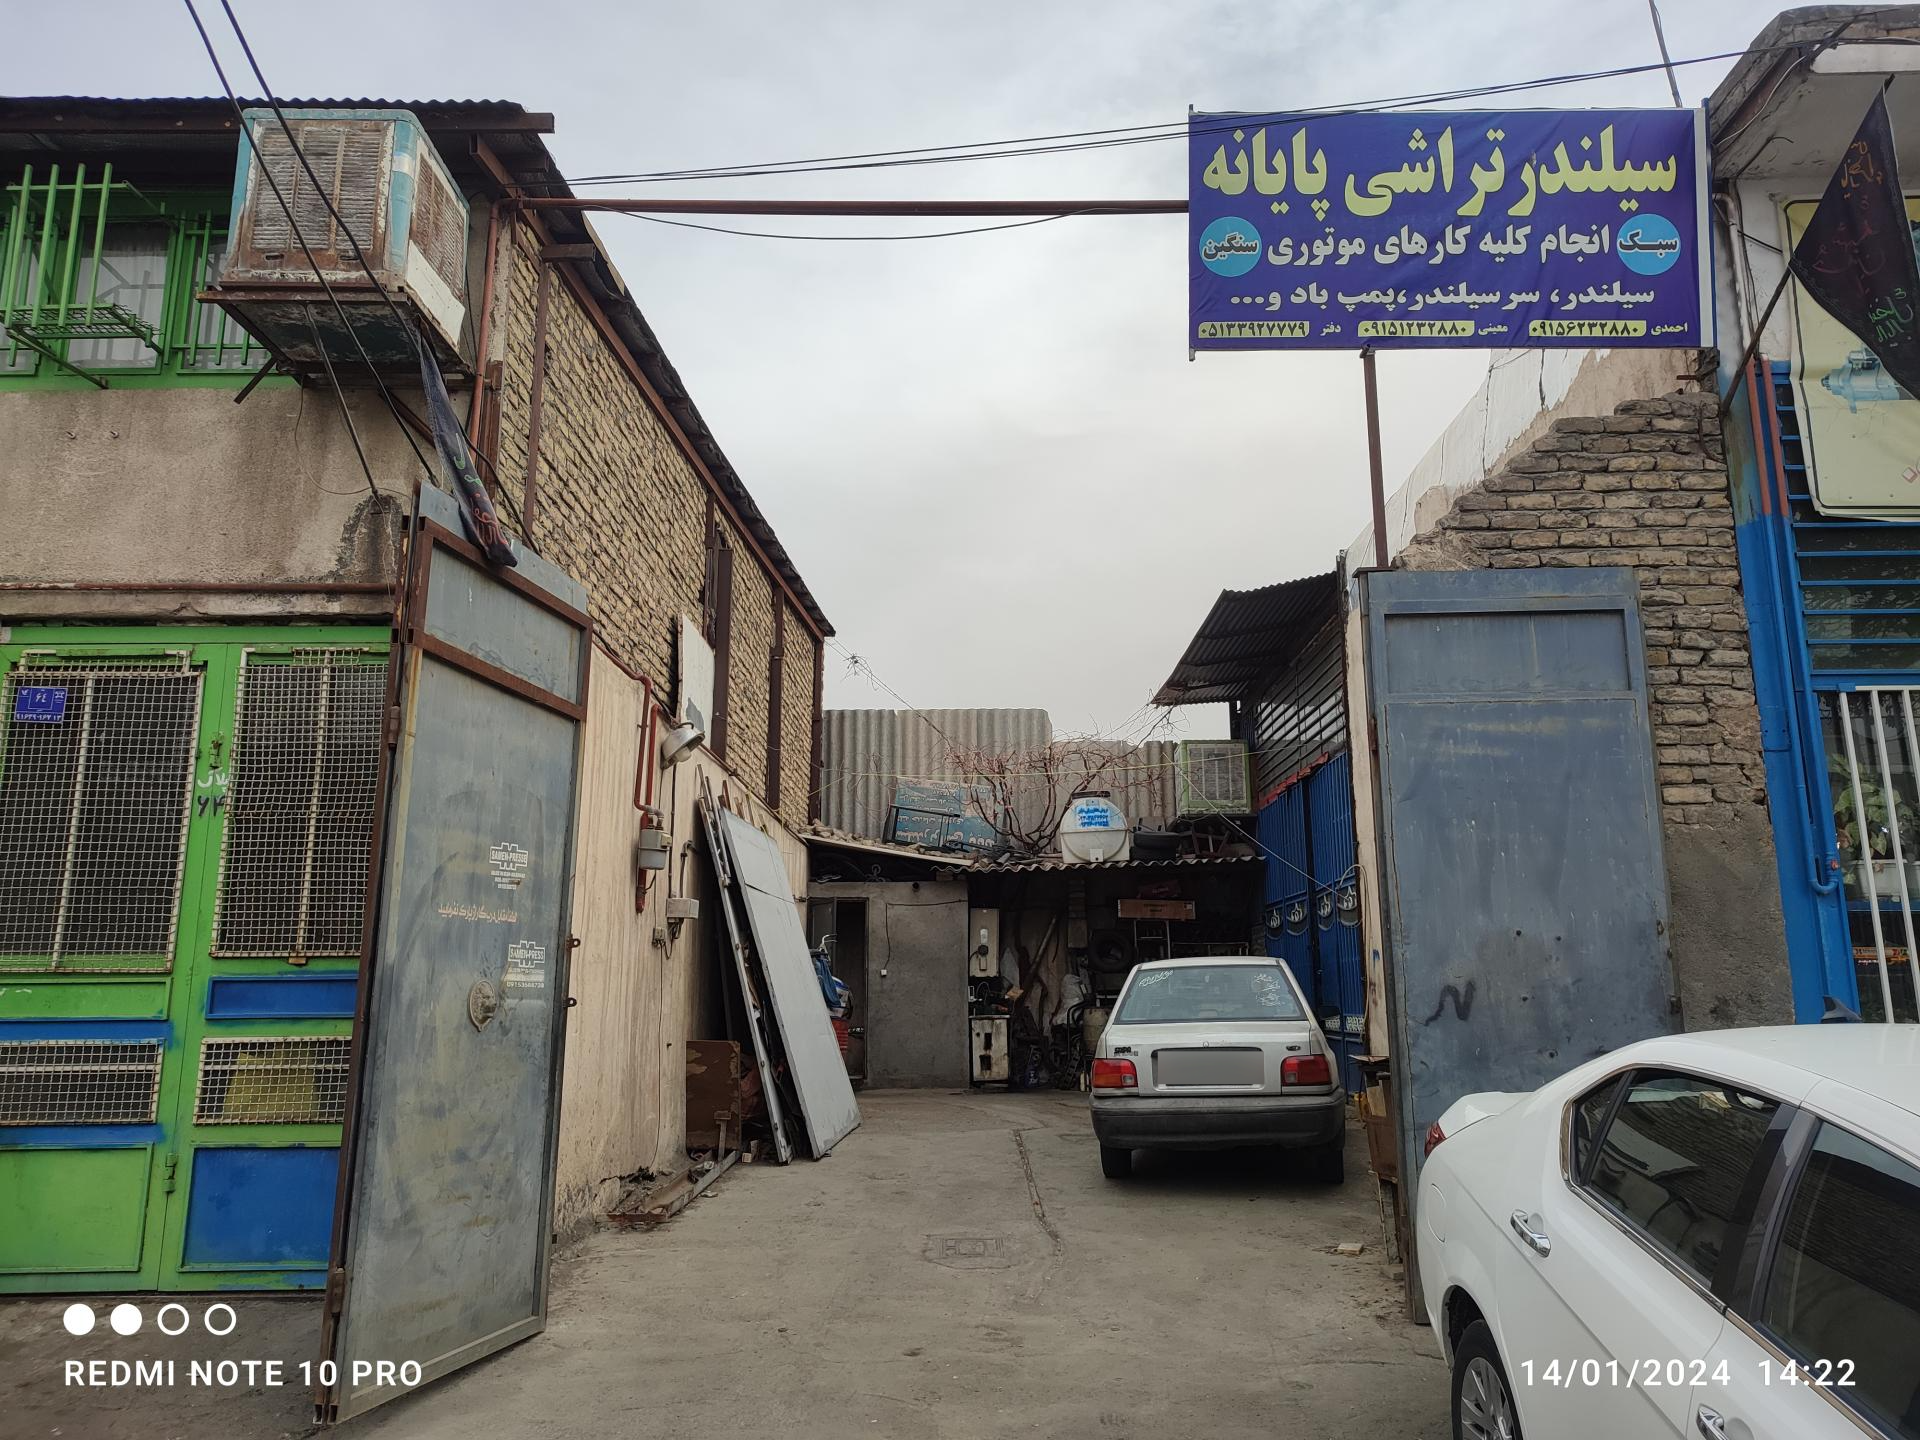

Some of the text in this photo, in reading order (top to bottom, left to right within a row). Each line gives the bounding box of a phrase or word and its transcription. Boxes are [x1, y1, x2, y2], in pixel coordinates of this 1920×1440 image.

[1202, 127, 1330, 222] پایانه
[1202, 231, 1259, 261] سنگین
[1267, 227, 1366, 265] موتوری
[1479, 224, 1532, 263] کلیه
[1540, 224, 1610, 264] انجام
[1617, 230, 1679, 258] سبک
[1290, 282, 1329, 310] باد
[1337, 287, 1395, 312] پمپ
[1319, 321, 1342, 337] دفتر
[1478, 322, 1509, 336] معینی
[1650, 321, 1688, 336] احمدی
